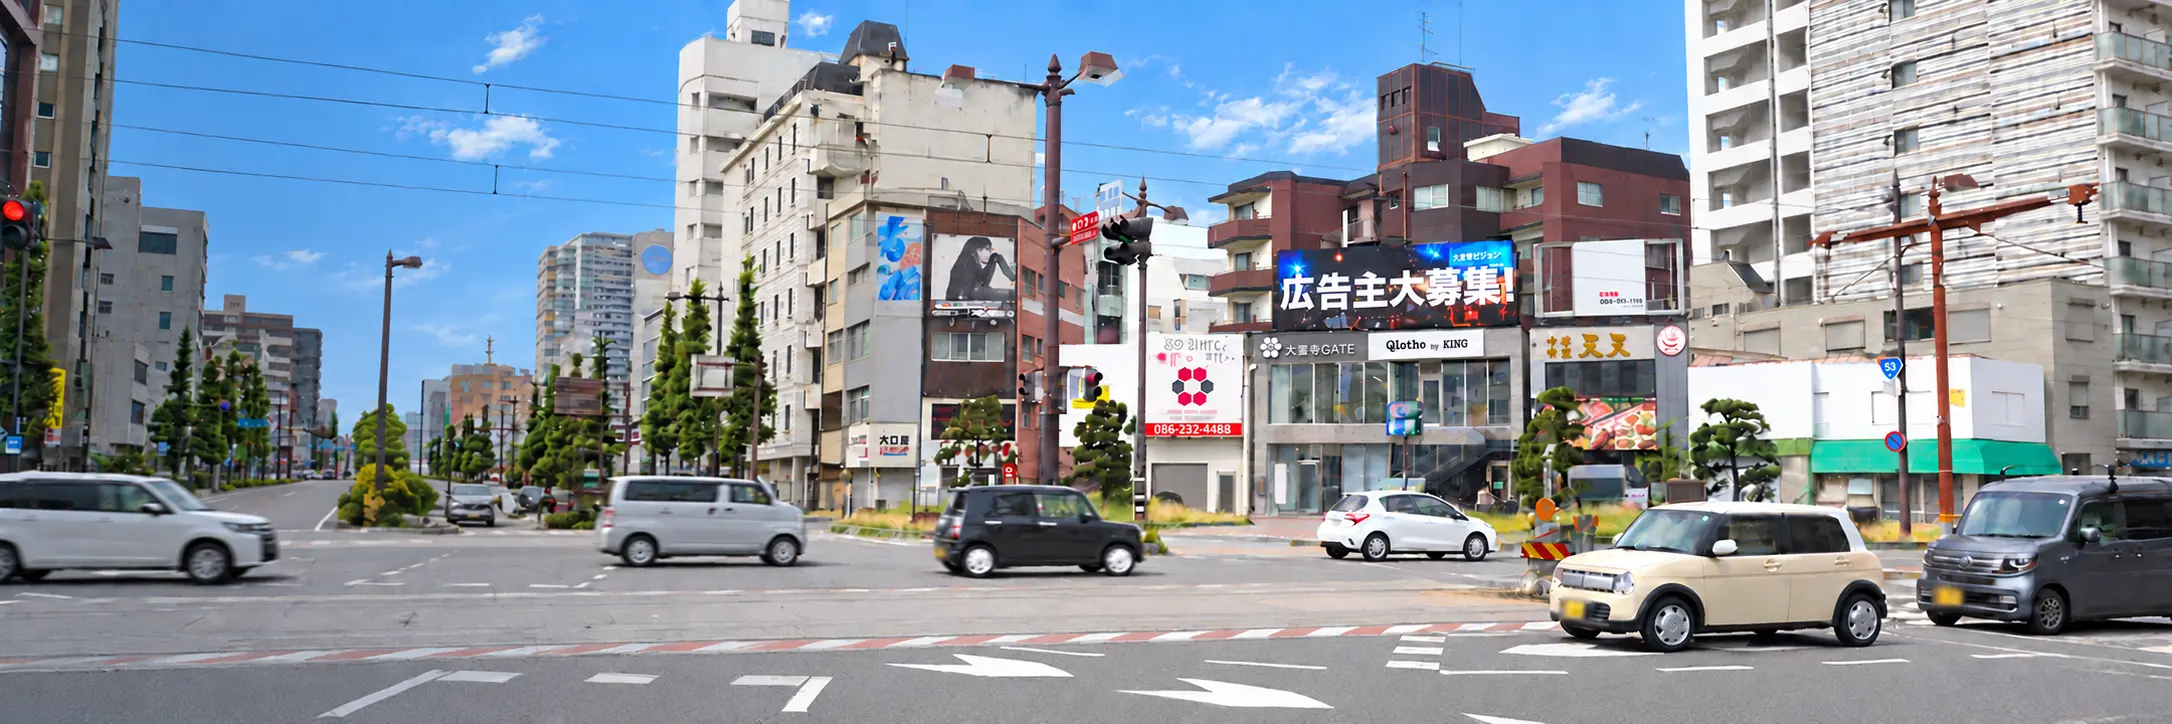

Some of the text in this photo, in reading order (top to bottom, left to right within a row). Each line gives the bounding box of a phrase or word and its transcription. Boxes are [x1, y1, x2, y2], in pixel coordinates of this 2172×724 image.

[1280, 265, 1515, 311] 広告主大募集!
[1386, 339, 1426, 352] Qlotho
[1443, 339, 1468, 349] KING
[1154, 423, 1231, 434] 086-232-4488
